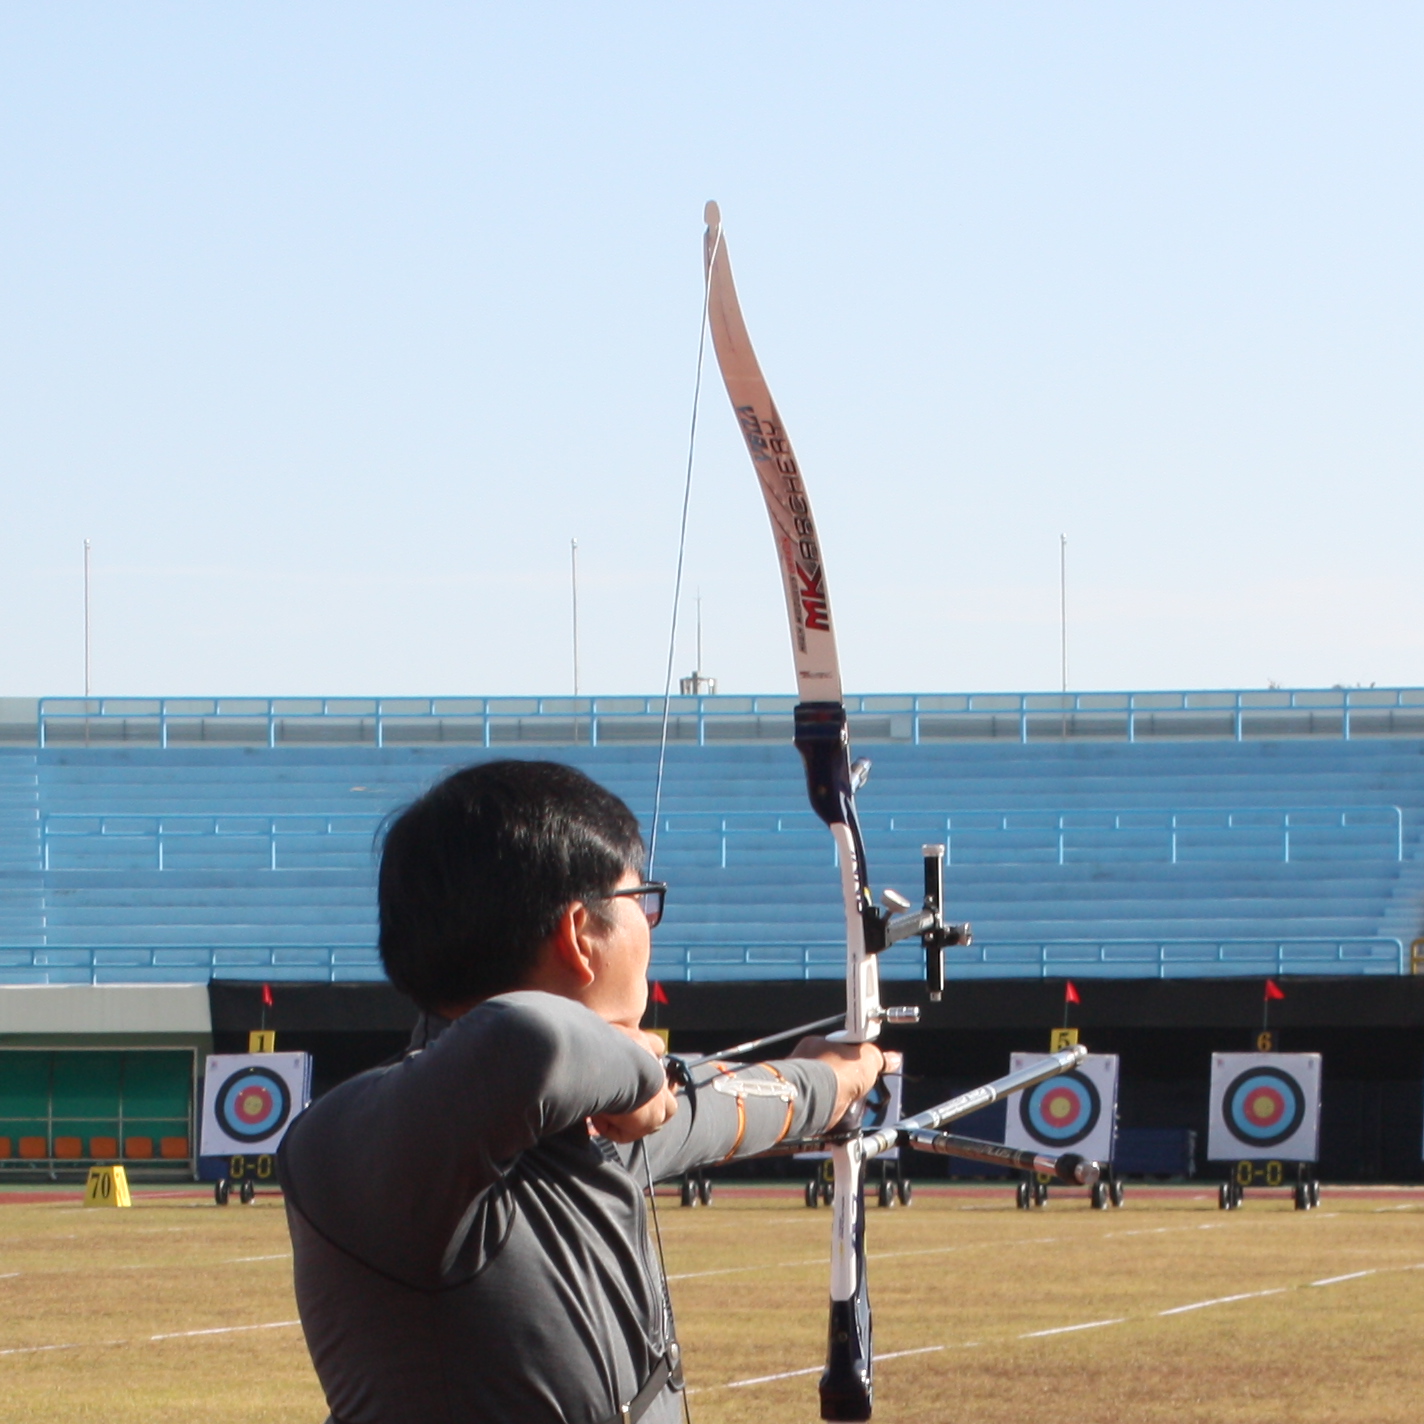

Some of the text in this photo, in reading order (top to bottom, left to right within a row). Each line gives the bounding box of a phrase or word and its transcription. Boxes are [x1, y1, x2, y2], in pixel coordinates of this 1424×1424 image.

[769, 419, 821, 564] ARCHERY
[796, 559, 831, 632] MK
[256, 1034, 266, 1052] 1
[1057, 1032, 1070, 1050] 5
[1257, 1032, 1272, 1052] 6
[230, 1154, 272, 1179] 0-0
[1236, 1160, 1283, 1186] 0-0
[90, 1171, 112, 1199] 70
